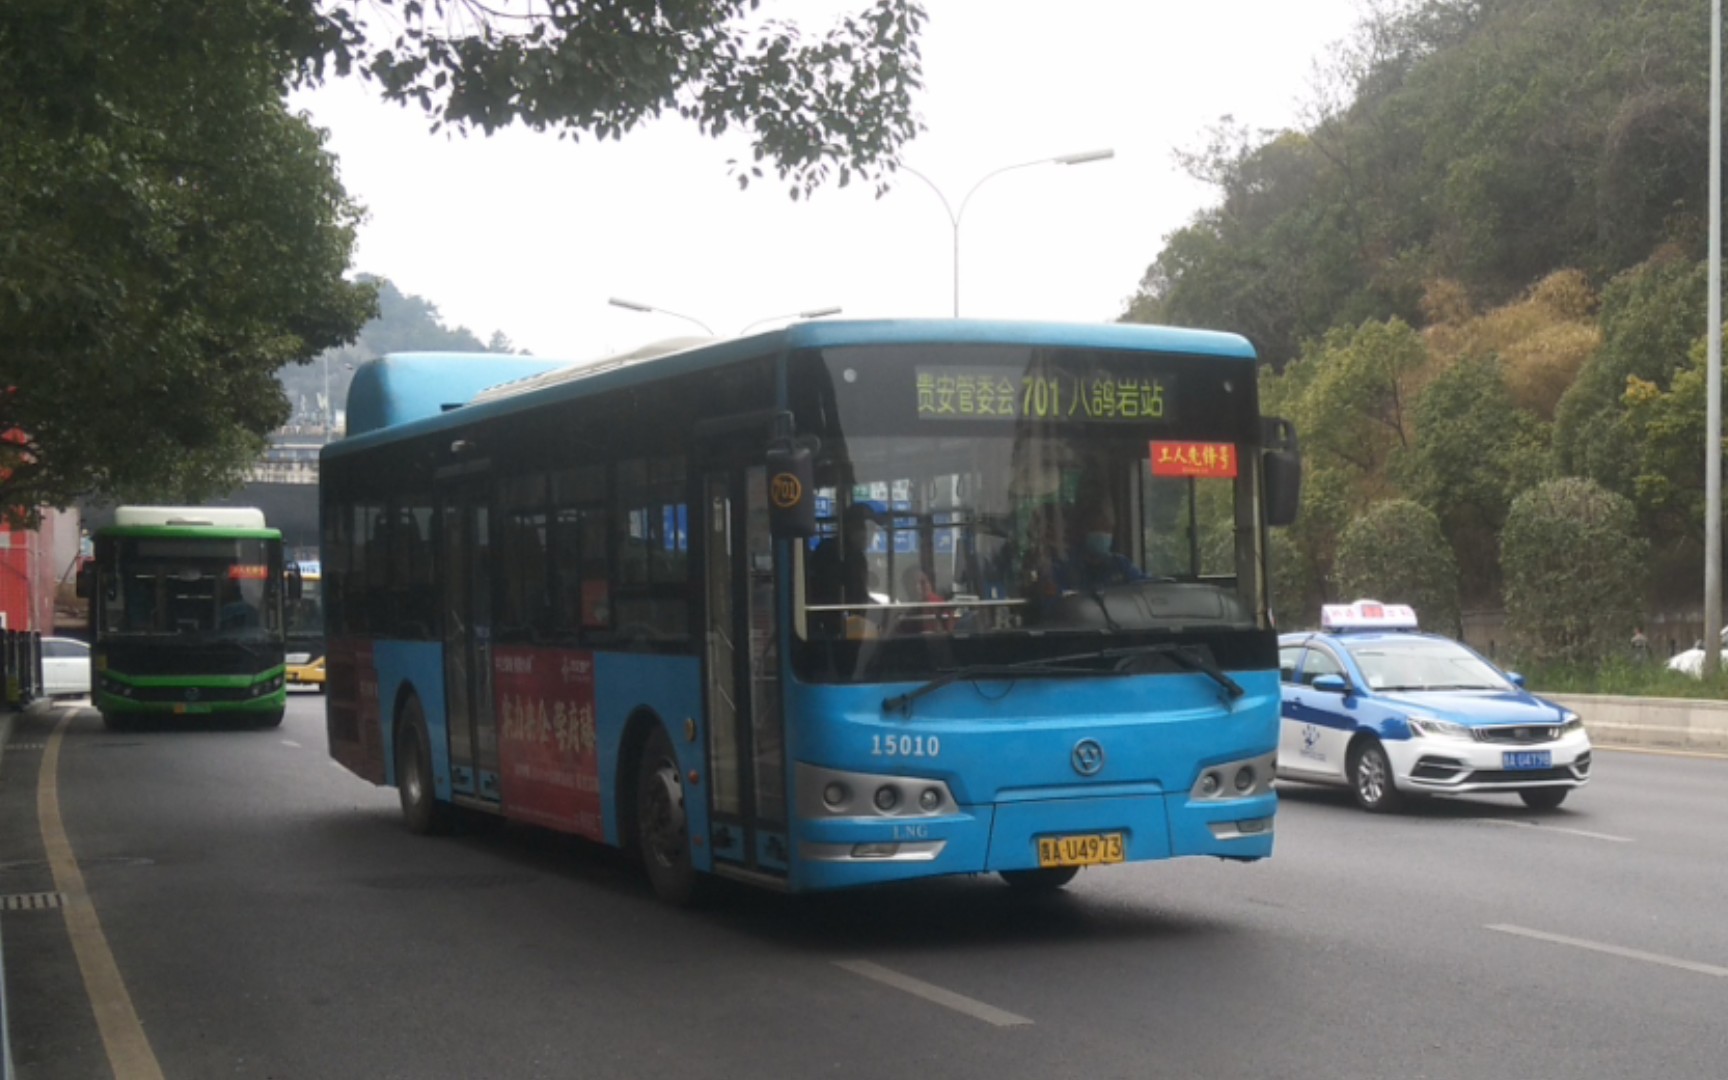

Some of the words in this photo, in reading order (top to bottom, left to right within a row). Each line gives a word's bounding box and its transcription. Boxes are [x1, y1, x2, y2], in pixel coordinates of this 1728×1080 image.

[916, 373, 1015, 415] 贵安管委会
[1021, 375, 1060, 416] 701
[1067, 376, 1165, 417] 八鸽岩站
[1157, 444, 1230, 470] 工人先锋号
[773, 478, 795, 498] 701
[871, 735, 941, 756] 15010
[893, 824, 929, 839] LNG
